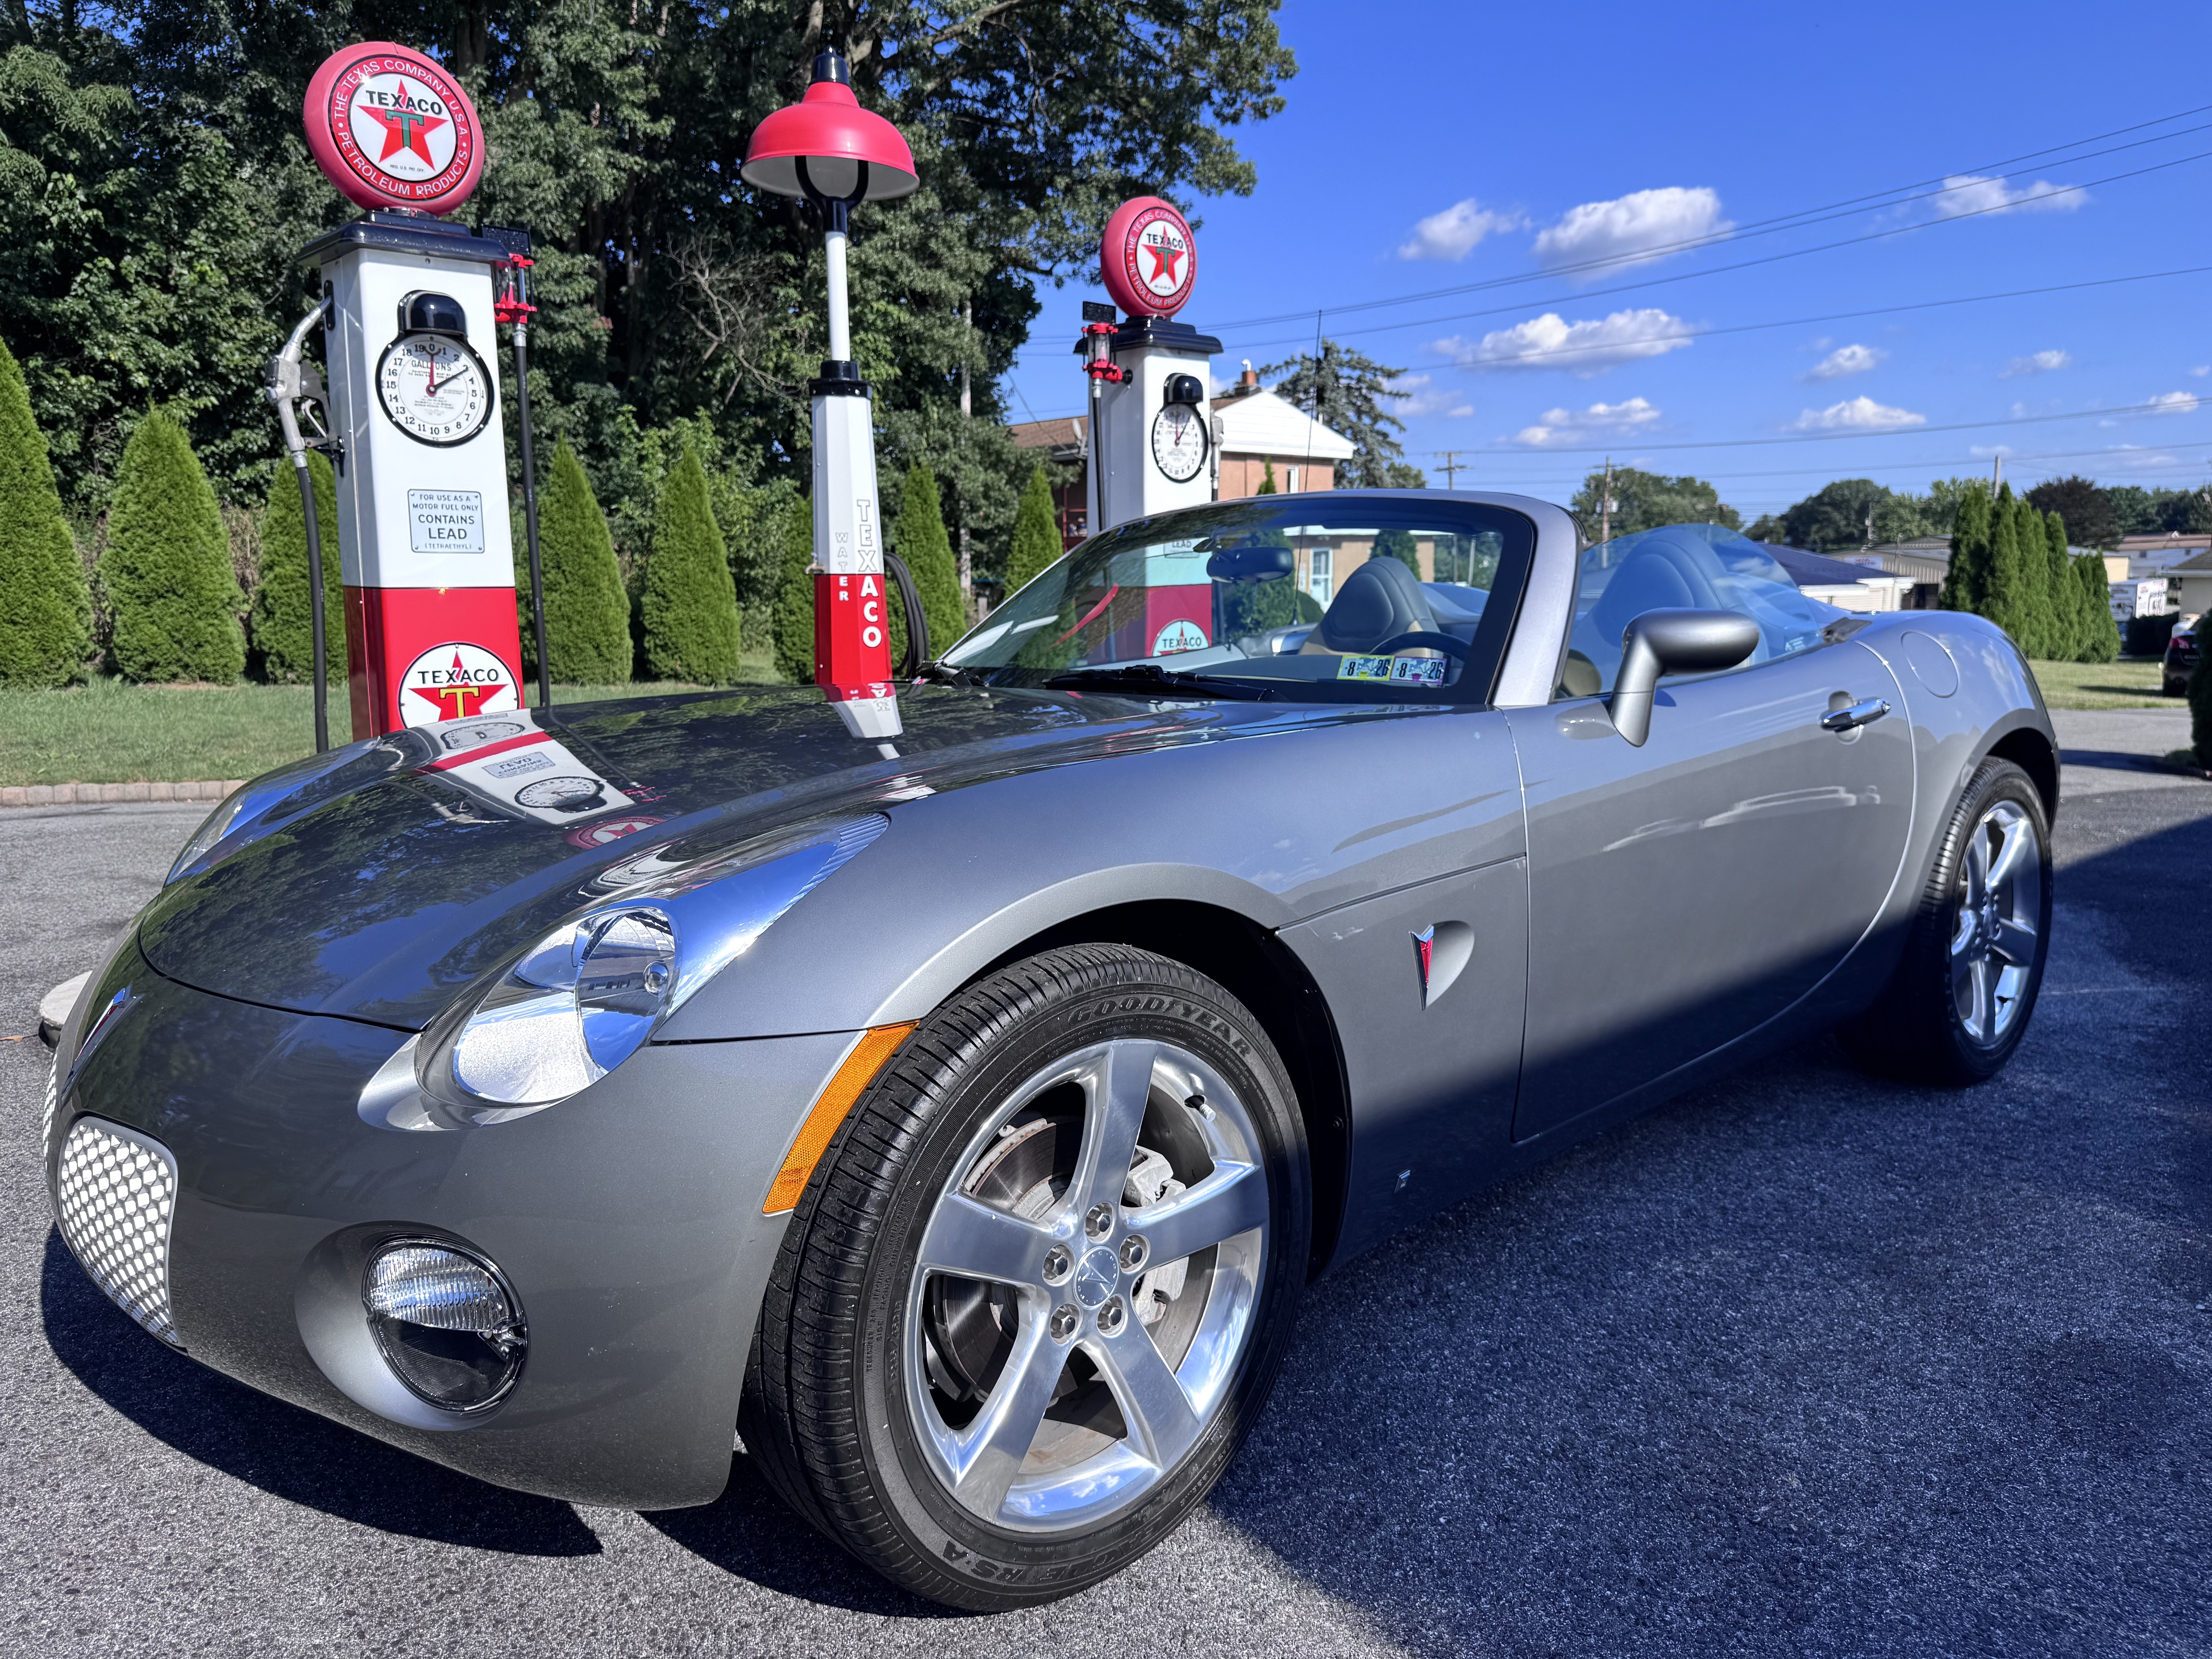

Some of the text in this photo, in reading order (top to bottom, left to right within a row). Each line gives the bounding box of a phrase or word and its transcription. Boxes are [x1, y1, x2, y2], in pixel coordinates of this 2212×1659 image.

[334, 92, 348, 120] THE
[342, 61, 380, 89] TEXAS
[384, 59, 450, 97] COMPANY
[366, 90, 442, 114] TEXACO
[385, 110, 424, 148] T
[337, 131, 468, 196] PETROLEUM PRODUCTS
[1128, 237, 1137, 254] THE
[1133, 213, 1154, 233] TEXAS
[1155, 211, 1187, 235] COMPANY
[1146, 233, 1183, 249] TEXACO
[1156, 247, 1175, 273] T
[1128, 264, 1162, 306] PETROLEUM
[443, 347, 447, 355] 1
[412, 360, 452, 371] GALLONS
[386, 381, 397, 389] 15
[430, 427, 440, 435] 10
[418, 514, 474, 524] CONTAINS
[428, 527, 467, 539] LEAD
[1172, 540, 1192, 548] LEAD
[835, 532, 849, 601] WATER
[857, 499, 882, 648] TEXACO
[1162, 637, 1202, 648] TEXACO
[417, 668, 499, 684] TEXACO
[1347, 659, 1389, 676] 8 26
[1399, 661, 1443, 679] 8 26
[439, 687, 480, 718] T
[1068, 996, 1251, 1057] GOODYEAR
